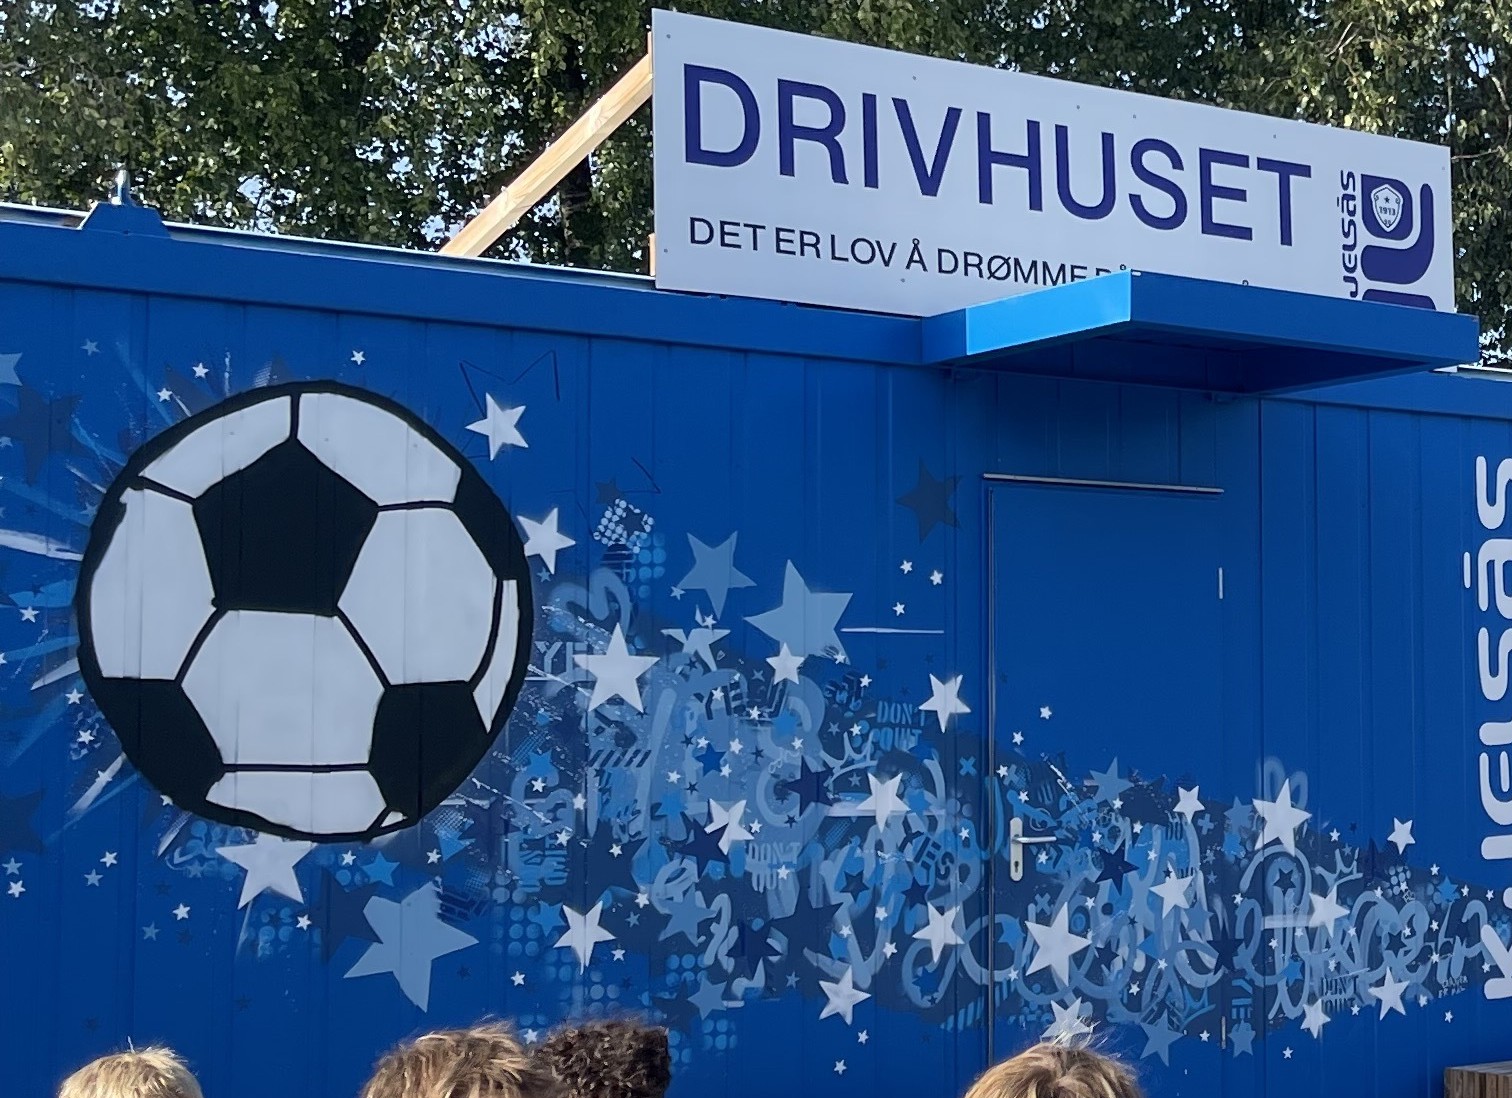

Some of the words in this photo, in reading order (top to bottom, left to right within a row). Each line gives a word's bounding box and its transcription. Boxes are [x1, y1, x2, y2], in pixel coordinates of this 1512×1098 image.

[683, 63, 1312, 247] DRIVHUSET
[1379, 206, 1397, 216] 1913
[689, 216, 766, 251] DET
[775, 226, 822, 259] ER
[830, 234, 898, 268] LOV
[905, 237, 929, 273] Å
[937, 247, 1088, 287] DRØMME
